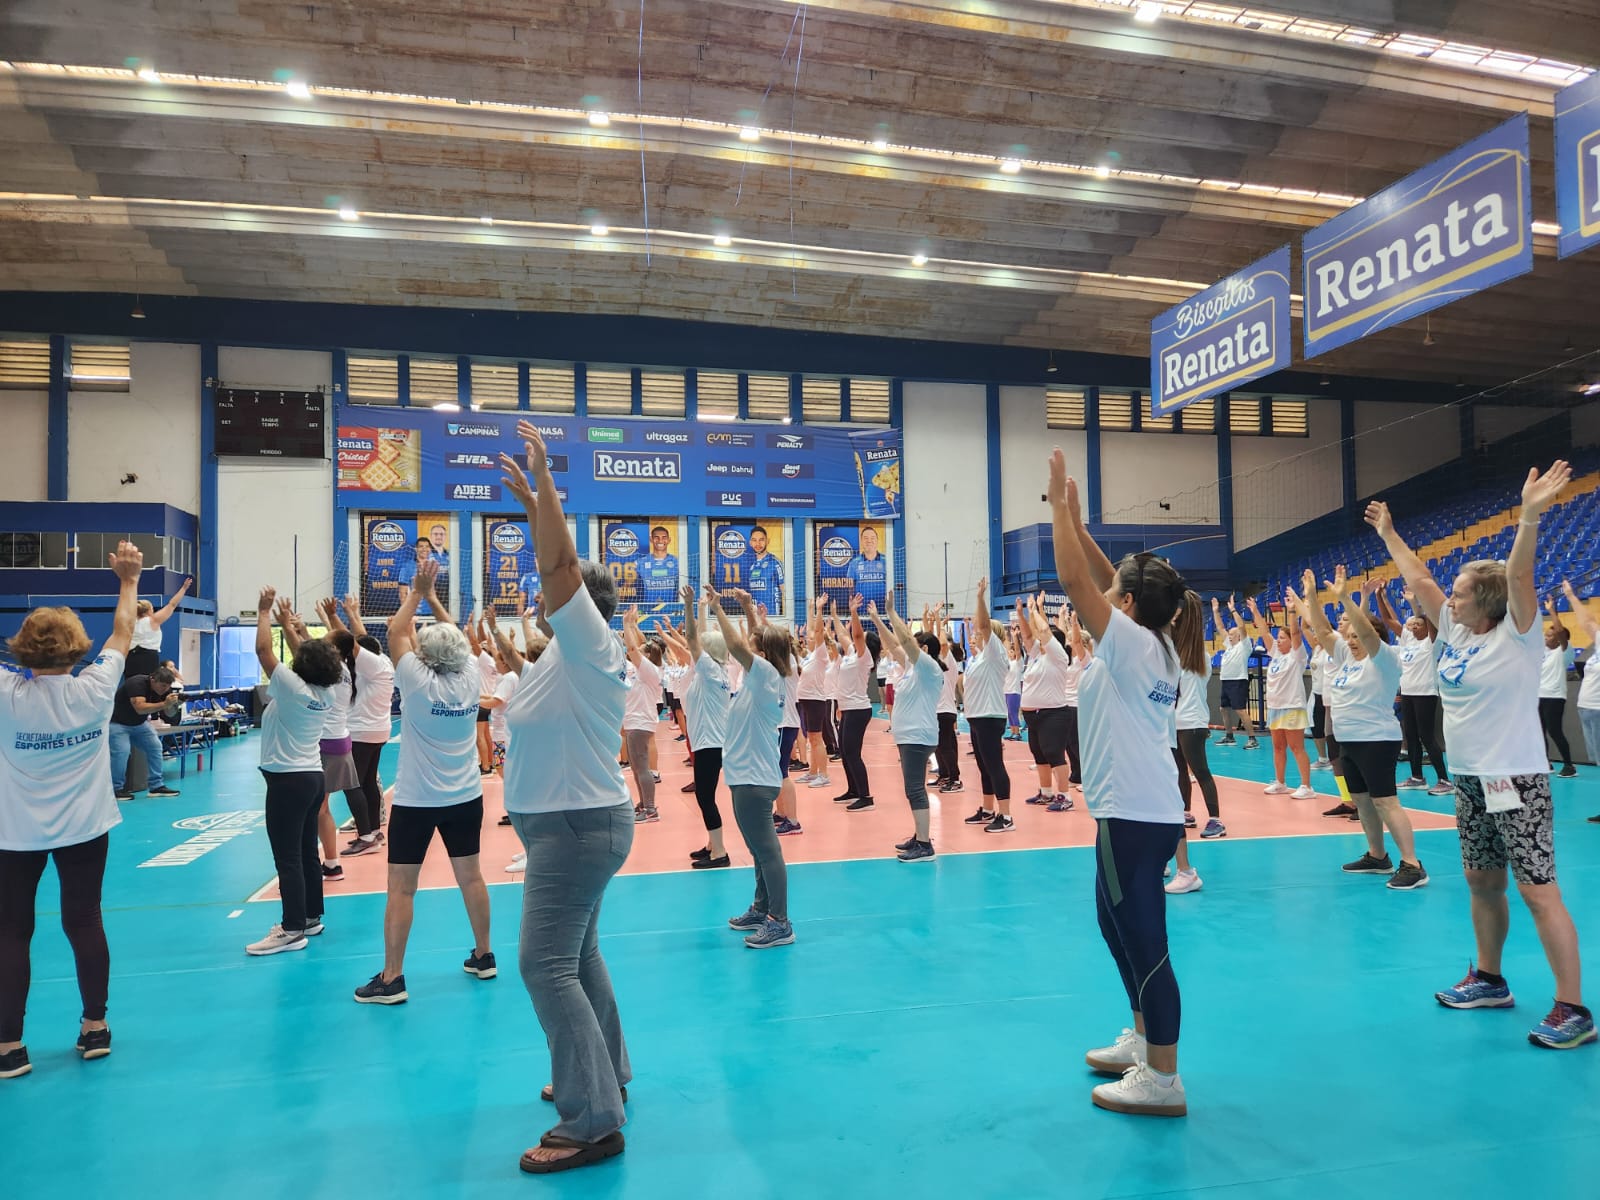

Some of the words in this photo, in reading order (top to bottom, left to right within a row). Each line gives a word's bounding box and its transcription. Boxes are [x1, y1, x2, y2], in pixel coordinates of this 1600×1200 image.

[1316, 193, 1509, 318] Renata
[1174, 277, 1255, 338] Biscoitos
[1164, 321, 1270, 395] Renata
[459, 427, 499, 436] CAMPINAS
[646, 431, 688, 443] ultragaz
[866, 449, 897, 460] Renata
[597, 455, 677, 477] Renata
[707, 464, 728, 472] Jeep
[731, 465, 753, 474] Dahruj
[454, 485, 491, 495] ADERE
[372, 533, 404, 541] Renata
[493, 535, 523, 543] Renata
[823, 548, 851, 556] Renata
[500, 556, 517, 570] 21
[609, 562, 637, 583] 06
[723, 563, 740, 583] 11
[501, 582, 518, 597] 12
[431, 708, 464, 717] ESPORTES
[15, 739, 65, 750] ESPORTES
[67, 737, 73, 746] E
[75, 729, 102, 744] LAZER
[16, 732, 53, 741] SECRETARIA
